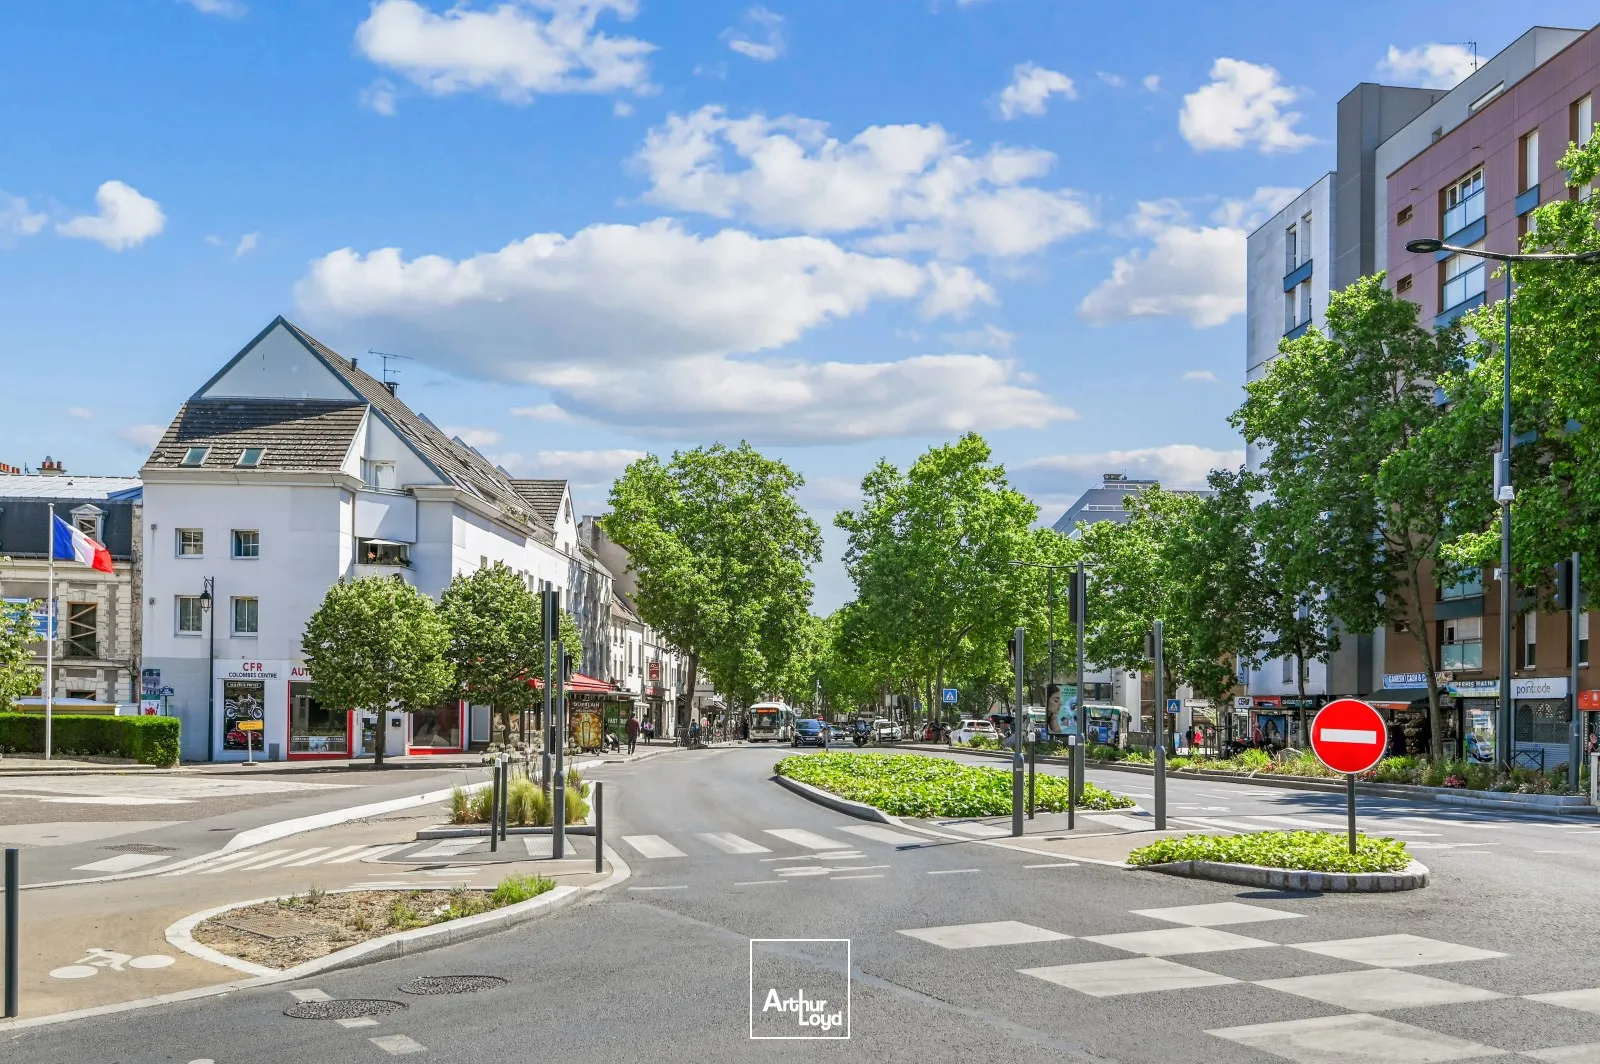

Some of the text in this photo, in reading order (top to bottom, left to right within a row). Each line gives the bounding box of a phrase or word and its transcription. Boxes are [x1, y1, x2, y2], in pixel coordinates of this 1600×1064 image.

[242, 662, 263, 672] CFR
[290, 666, 311, 677] AUT
[228, 671, 257, 679] COLOMBES
[1516, 683, 1551, 696] pointcode
